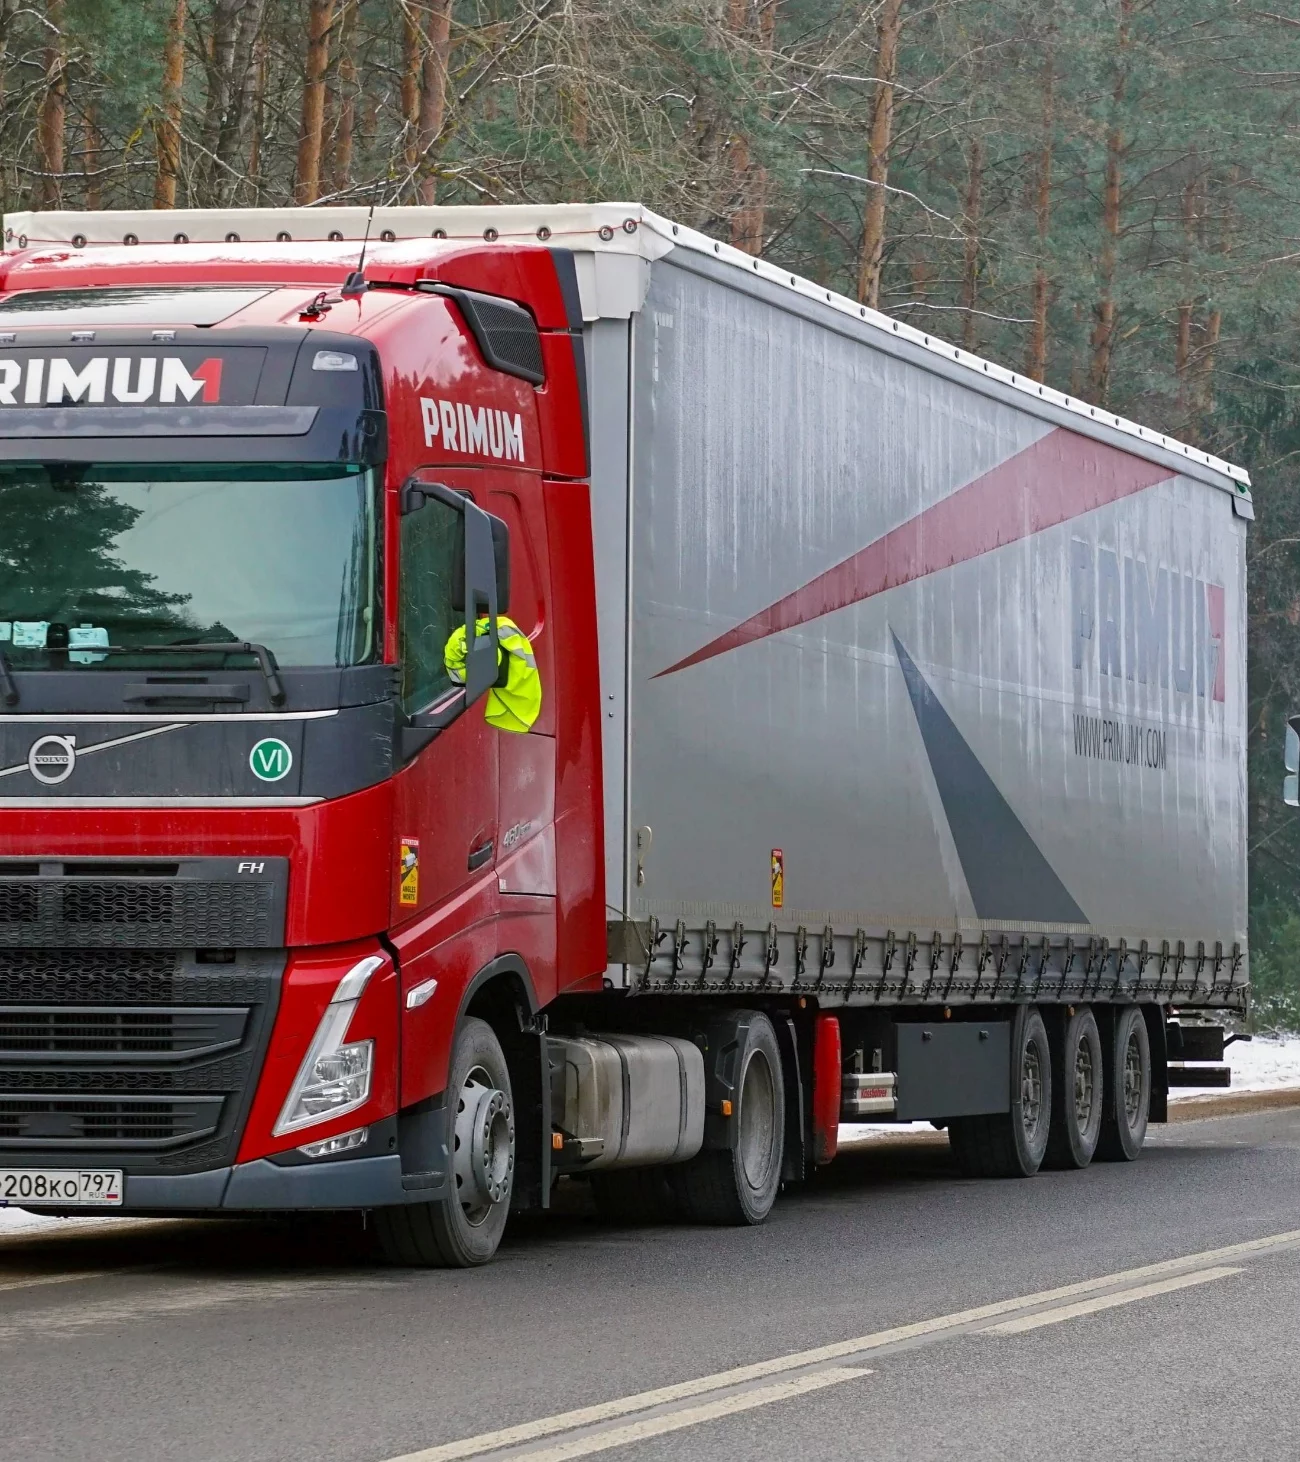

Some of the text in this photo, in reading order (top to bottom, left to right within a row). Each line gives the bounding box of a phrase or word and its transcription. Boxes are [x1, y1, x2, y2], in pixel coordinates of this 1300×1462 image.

[420, 396, 525, 462] PRIMUM
[257, 749, 283, 773] VI
[237, 862, 265, 874] FH
[0, 1174, 115, 1198] 208KO 797
[89, 1191, 106, 1199] RUS
